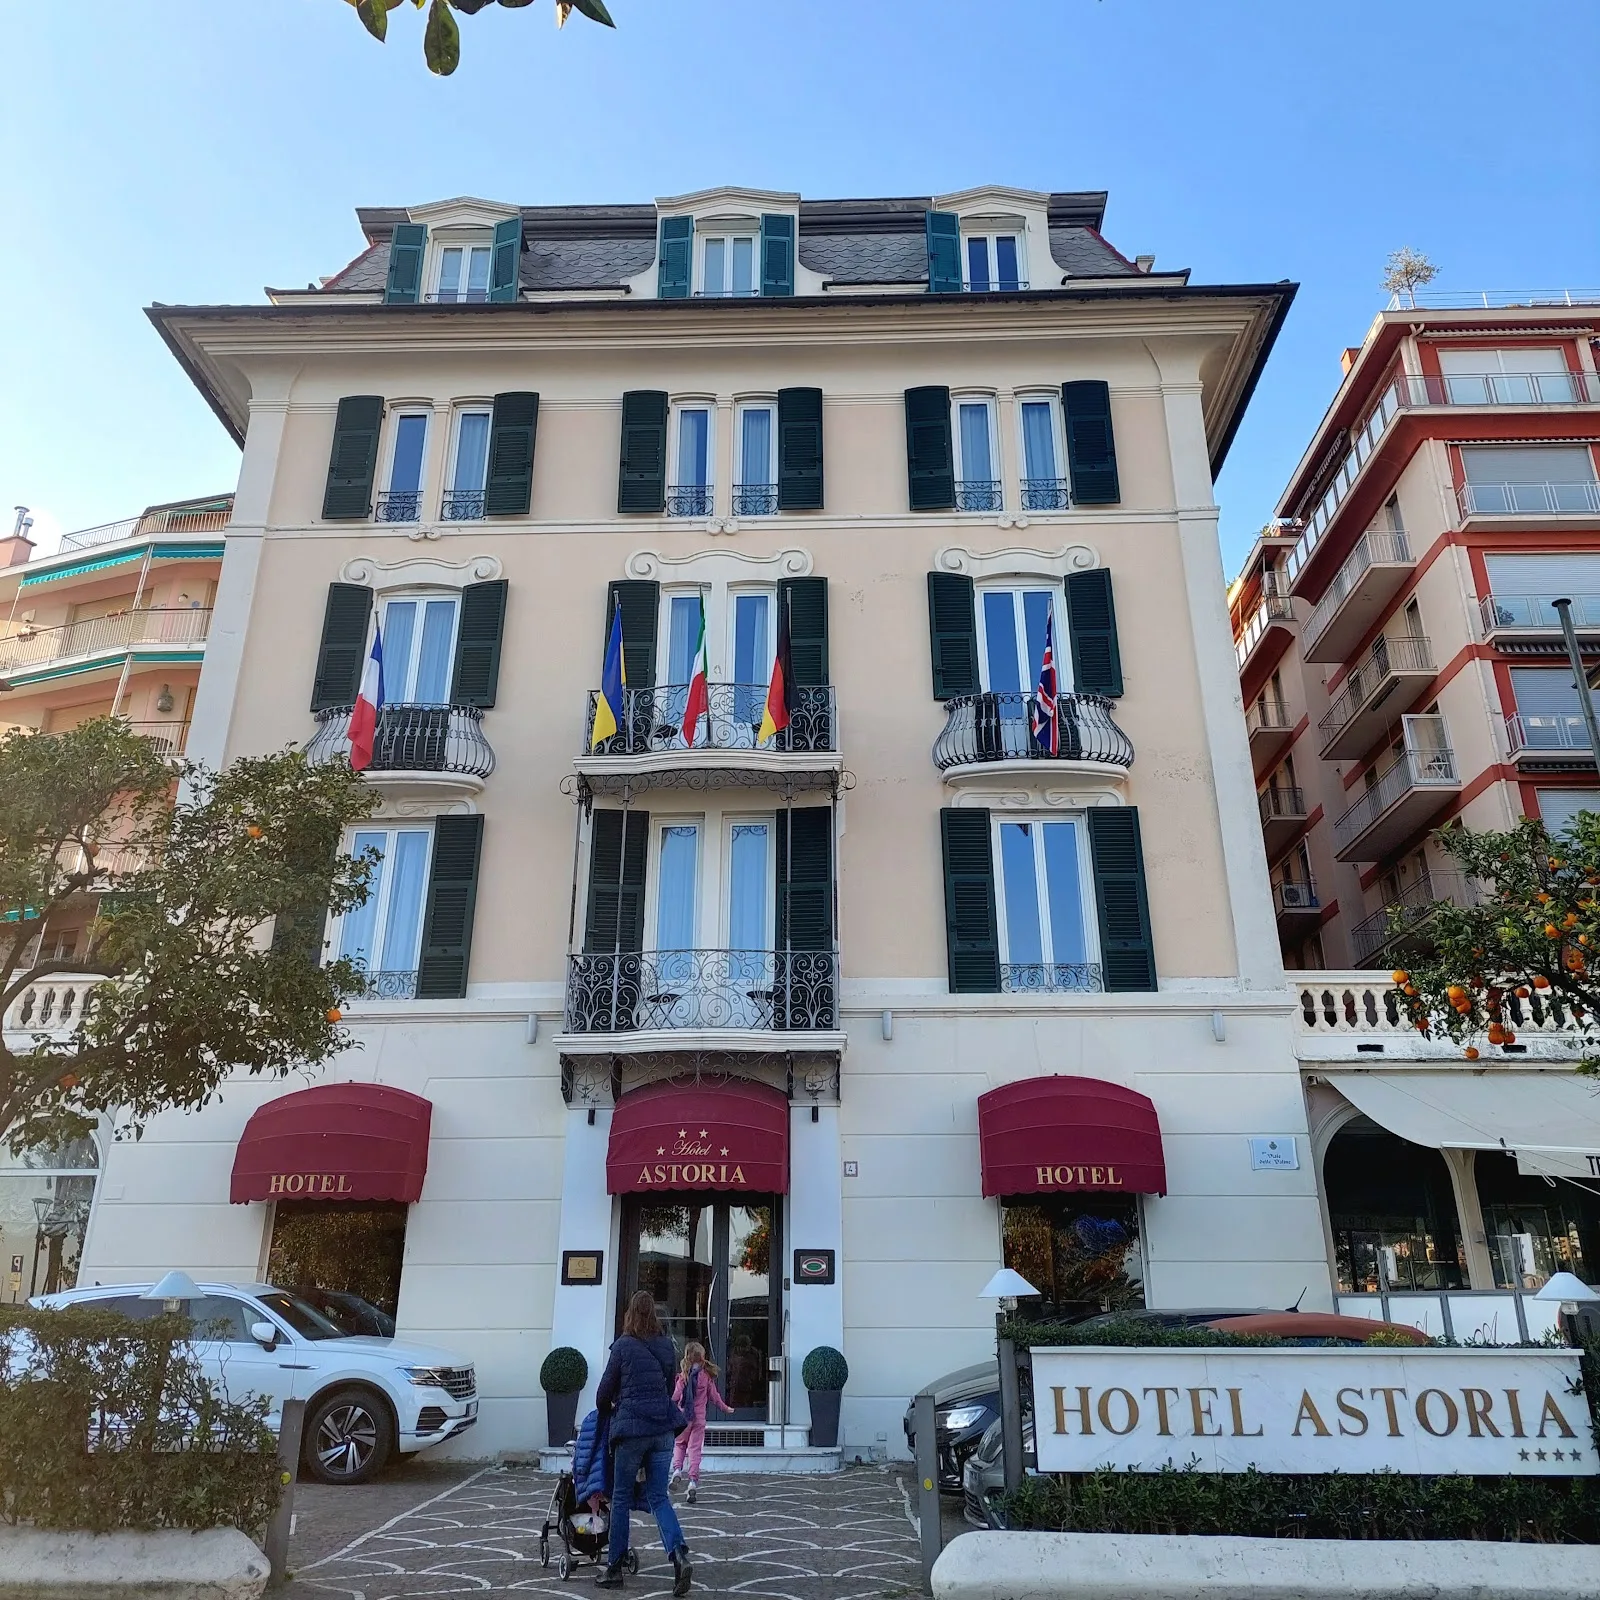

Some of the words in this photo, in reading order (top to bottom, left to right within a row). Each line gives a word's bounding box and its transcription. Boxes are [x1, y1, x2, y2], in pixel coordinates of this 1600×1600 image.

[671, 1139, 713, 1156] Hotel
[268, 1173, 354, 1194] HOTEL
[636, 1164, 747, 1184] ASTORIA
[1035, 1165, 1123, 1186] HOTEL
[1049, 1386, 1264, 1438] HOTEL
[1291, 1387, 1579, 1440] ASTORIA
